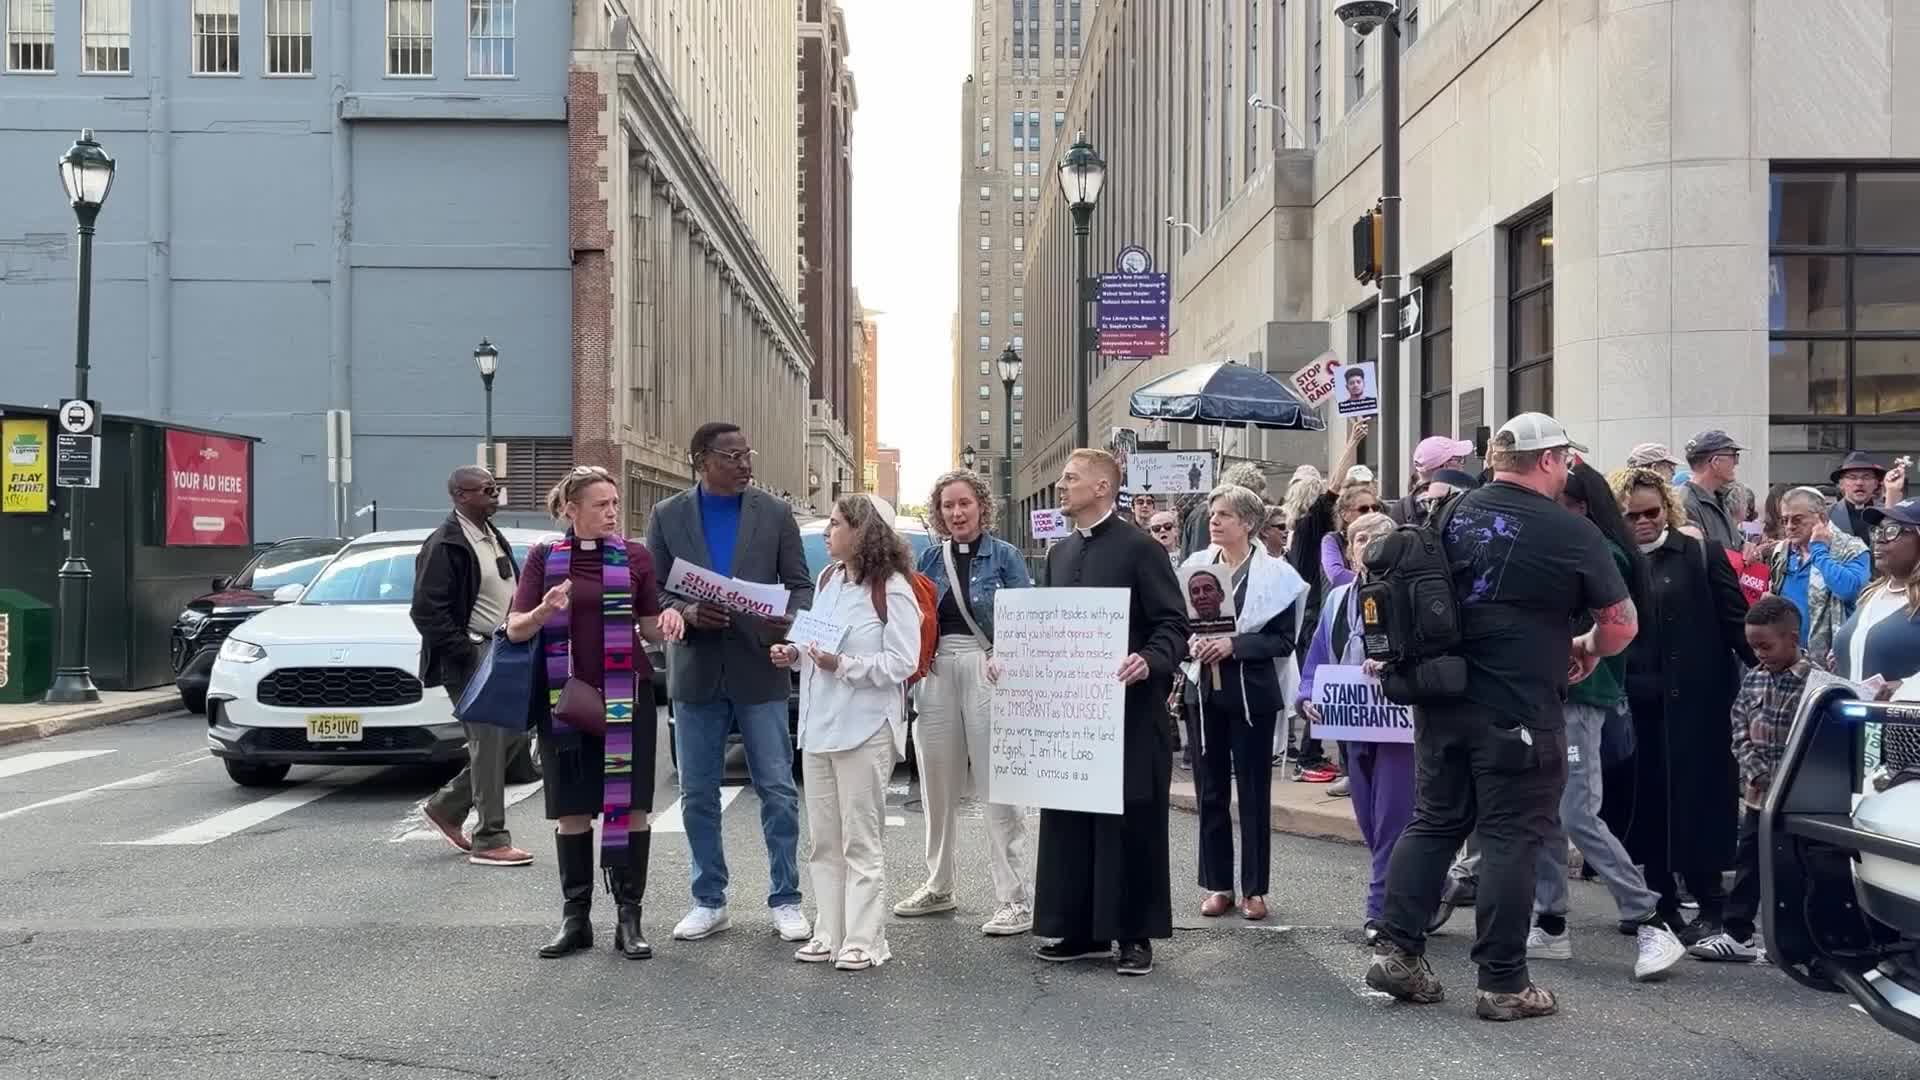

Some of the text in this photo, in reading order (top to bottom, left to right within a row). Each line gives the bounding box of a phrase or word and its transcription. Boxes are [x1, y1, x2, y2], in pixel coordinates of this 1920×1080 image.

[1296, 363, 1321, 387] STOP
[1301, 379, 1320, 395] ICE
[11, 473, 42, 482] PLAY
[172, 470, 242, 493] YOUR AD HERE
[726, 591, 775, 614] down
[1090, 605, 1109, 620] with
[1109, 611, 1125, 624] you
[1054, 626, 1067, 639] not
[1021, 642, 1035, 657] The
[1035, 665, 1045, 679] be
[1055, 669, 1067, 684] you
[1077, 665, 1090, 679] the
[1011, 688, 1034, 702] among
[1051, 690, 1063, 703] you
[1086, 683, 1113, 701] LOVE
[1322, 682, 1369, 706] STAND
[1008, 701, 1050, 718] IMMIGRANT
[1052, 709, 1060, 719] as
[310, 719, 331, 735] T45
[1005, 727, 1016, 740] you
[1018, 727, 1032, 738] were
[1034, 723, 1070, 744] immigrants
[1072, 729, 1081, 740] in
[1083, 725, 1096, 741] the
[1098, 725, 1116, 742] land
[993, 741, 1001, 755] of
[1029, 740, 1038, 758] I
[1039, 746, 1051, 758] am
[1053, 741, 1068, 760] the
[993, 763, 1010, 780] your
[1037, 769, 1070, 781] LEVITICUS
